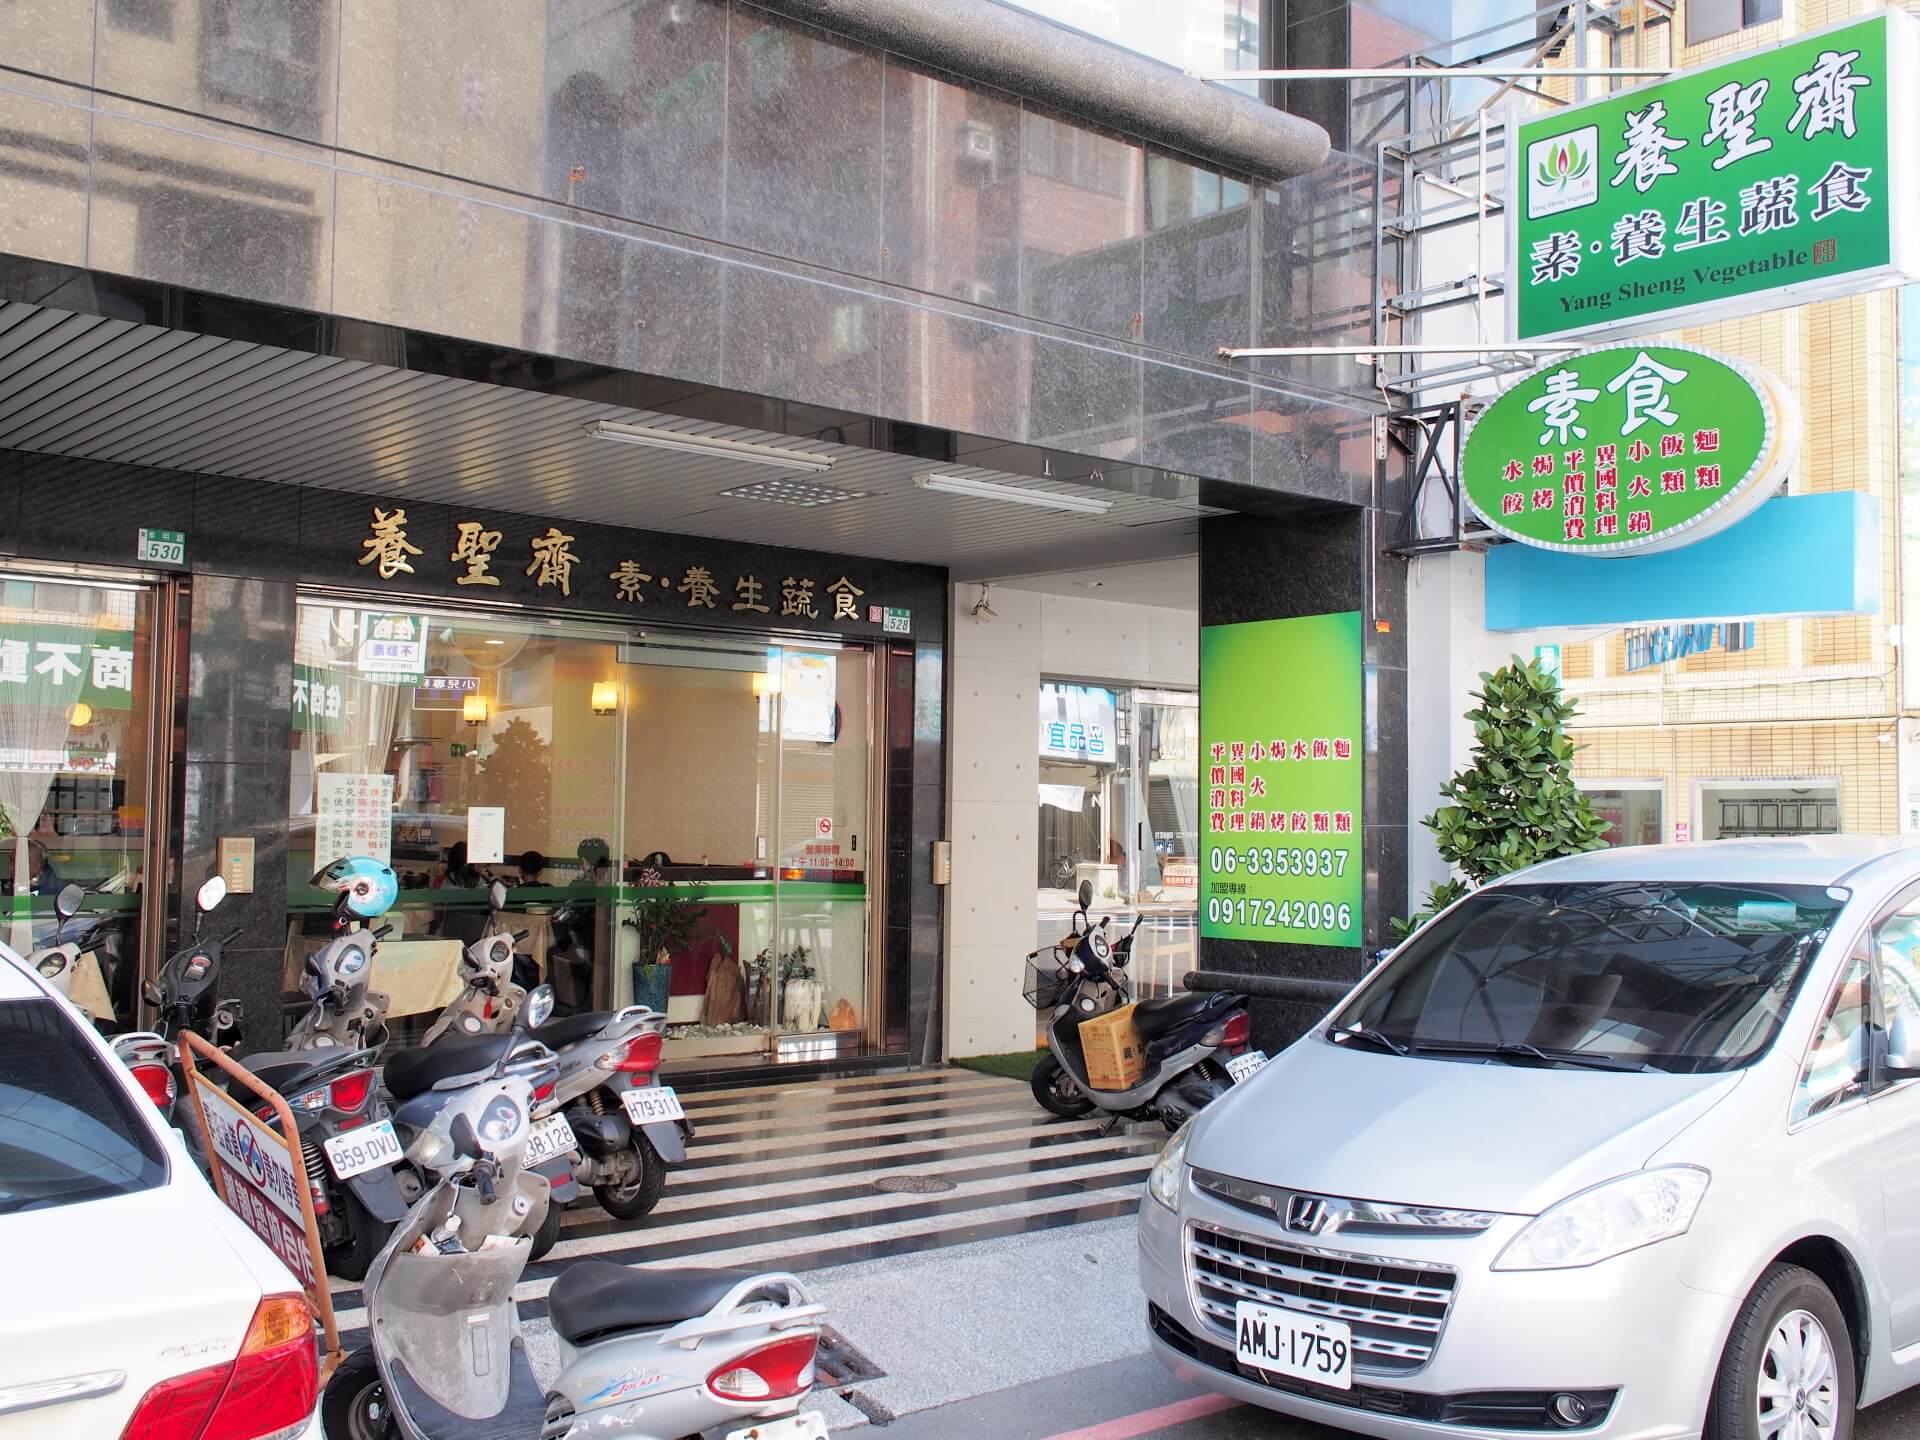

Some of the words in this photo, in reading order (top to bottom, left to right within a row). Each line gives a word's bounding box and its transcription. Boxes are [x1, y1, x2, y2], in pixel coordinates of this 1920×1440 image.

[1560, 291, 1611, 314] Yang
[1618, 276, 1686, 302] Sheng
[1693, 249, 1808, 285] Vegetable
[1526, 351, 1689, 447] 素食
[150, 543, 181, 560] 530
[890, 618, 909, 631] 528
[1210, 847, 1350, 878] 06-3353937
[1208, 897, 1352, 931] 0917242096
